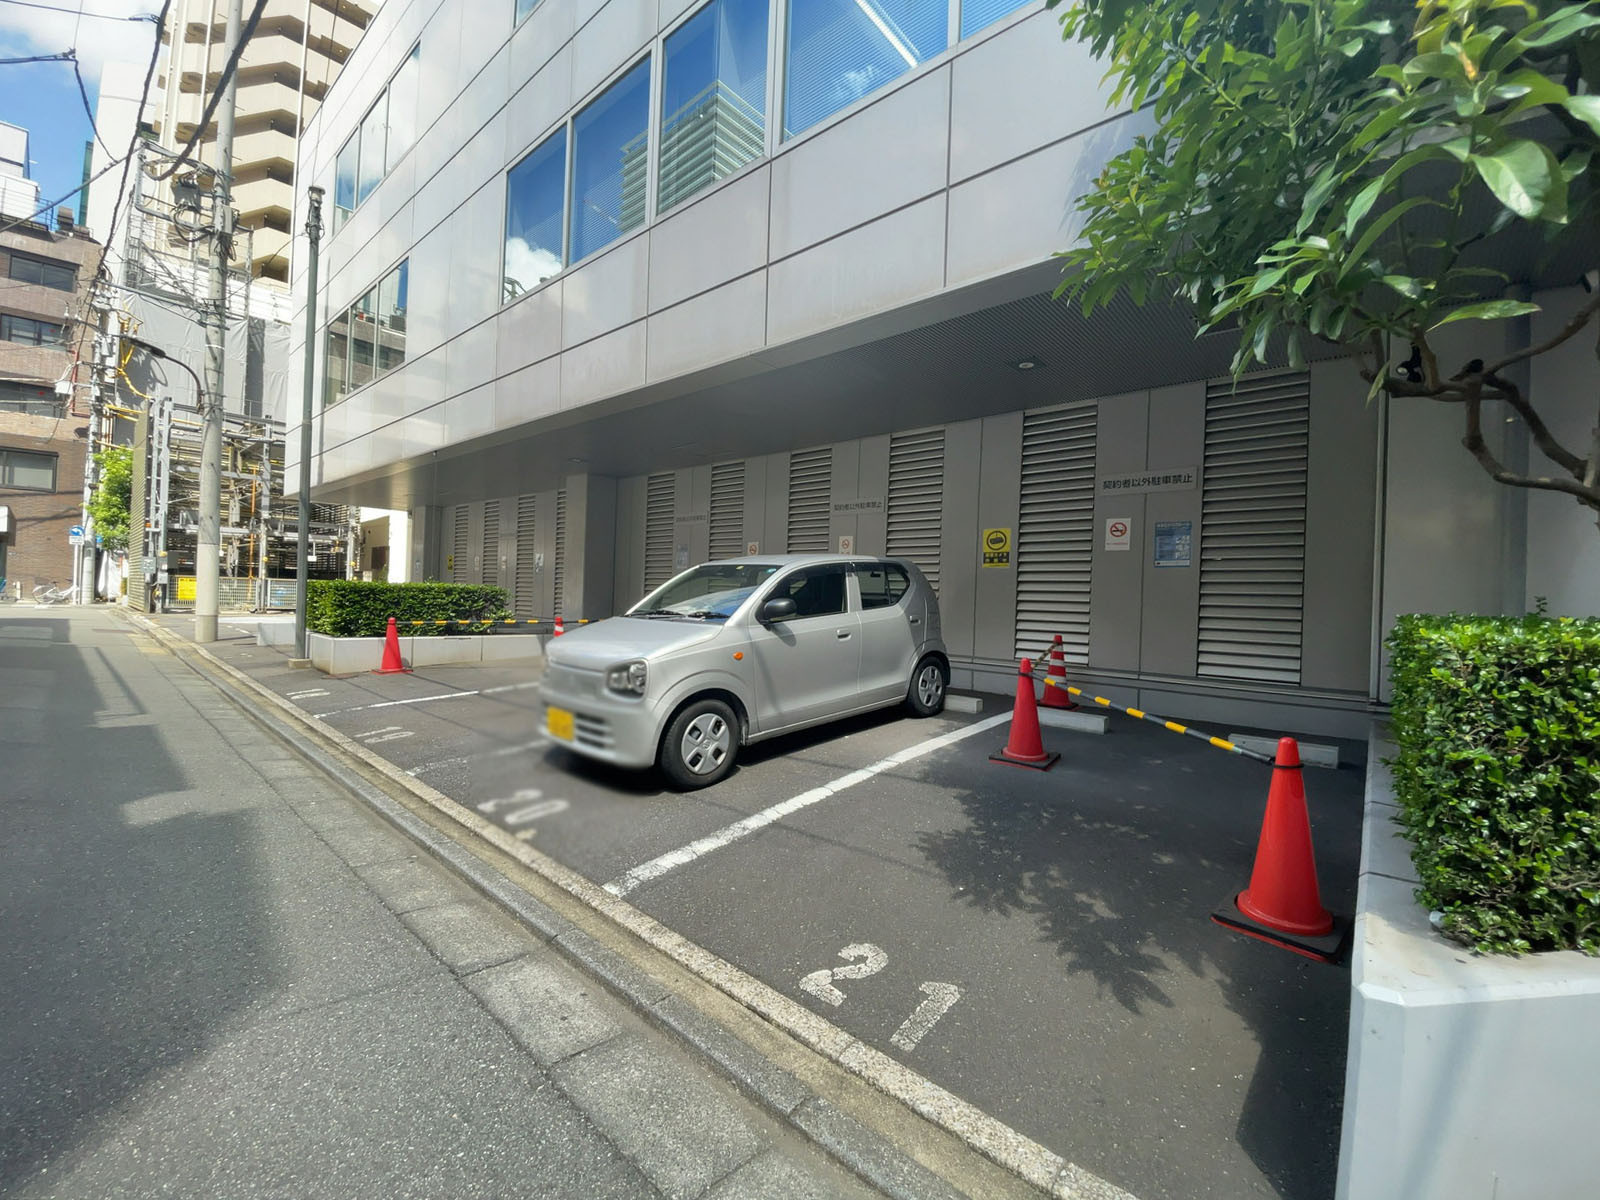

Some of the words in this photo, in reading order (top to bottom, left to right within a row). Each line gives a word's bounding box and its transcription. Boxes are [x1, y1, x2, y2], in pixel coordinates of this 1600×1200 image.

[1103, 473, 1193, 490] 契約者以外駐車禁止
[477, 788, 570, 825] 20
[799, 943, 960, 1051] 21
